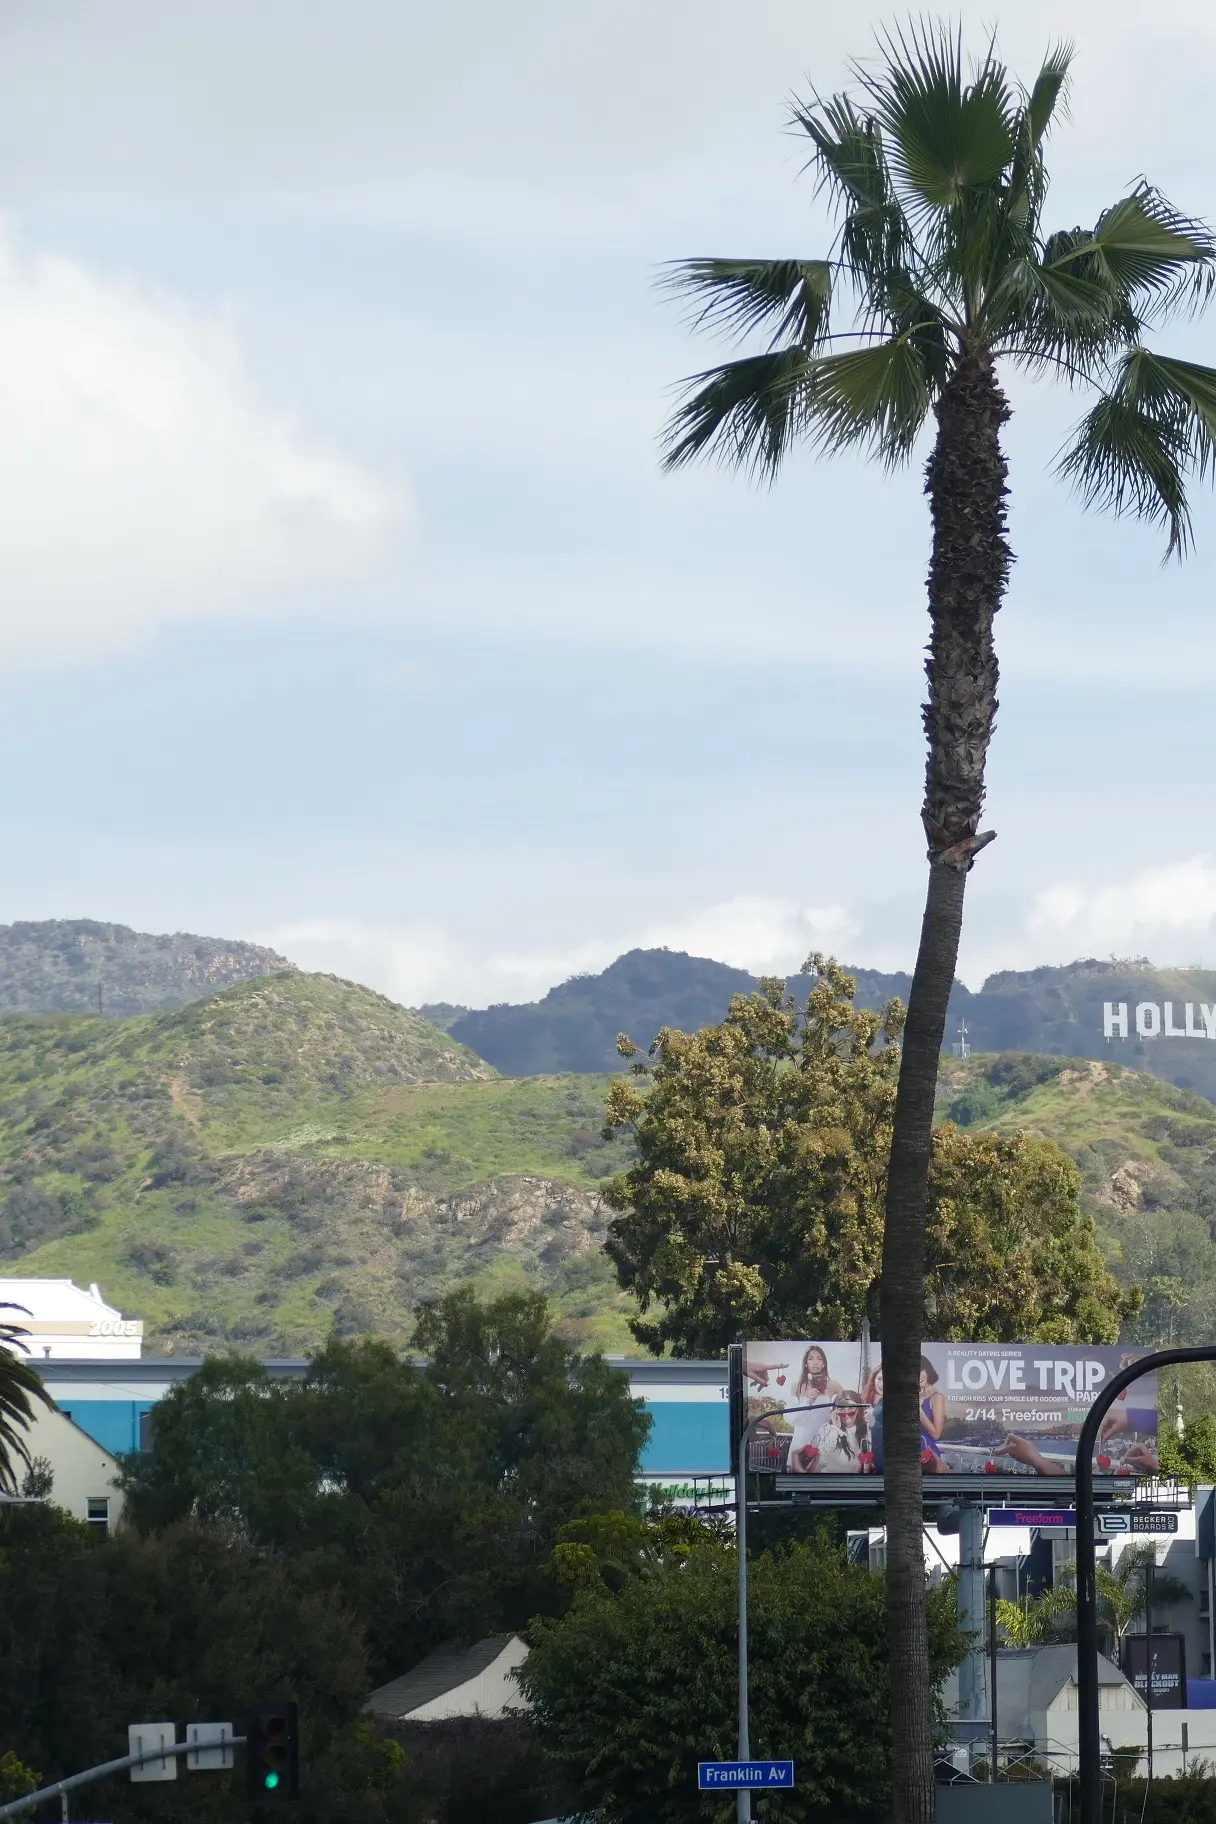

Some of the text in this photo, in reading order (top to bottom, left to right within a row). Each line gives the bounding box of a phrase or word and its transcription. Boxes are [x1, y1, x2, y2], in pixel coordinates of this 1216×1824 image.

[88, 1320, 138, 1337] 2005
[947, 1359, 1106, 1399] LOVE TRIP
[1076, 1391, 1101, 1402] PAR
[965, 1408, 1062, 1422] 2/14 Freeform
[1015, 1513, 1064, 1524] Freeform
[706, 1767, 786, 1782] Franklin Av
